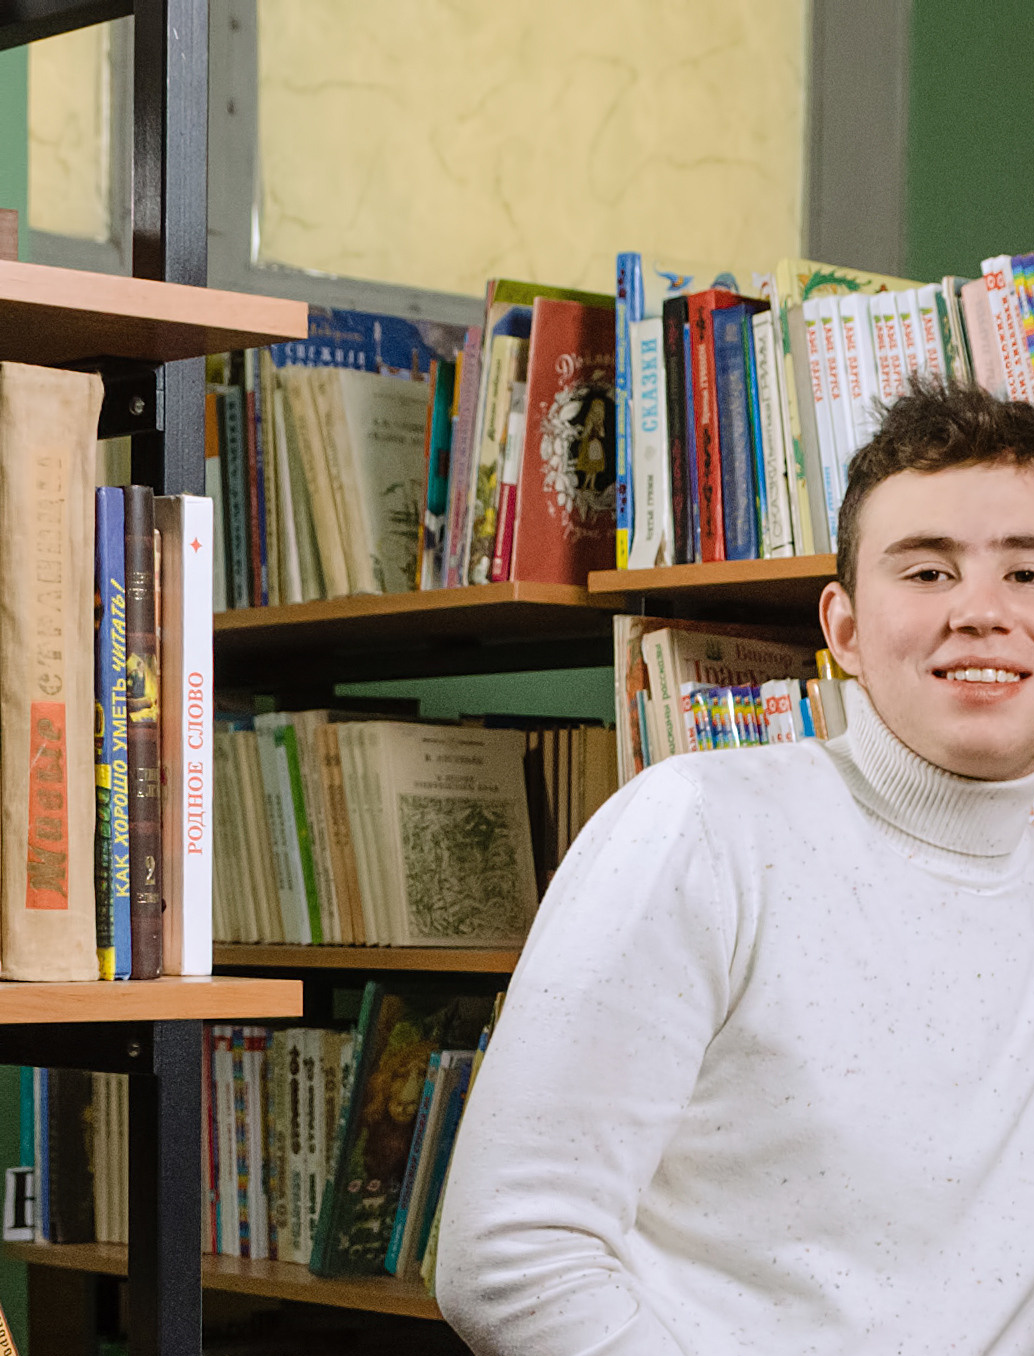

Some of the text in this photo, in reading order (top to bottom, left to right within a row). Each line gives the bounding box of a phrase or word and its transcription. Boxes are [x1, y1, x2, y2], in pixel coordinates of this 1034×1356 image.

[641, 338, 658, 432] СКАЗКИ
[109, 579, 130, 897] КАК ХОРОШО УМЕТЬ ЧИТАТЬ!
[186, 671, 205, 855] РОДНОЕ СЛОВО
